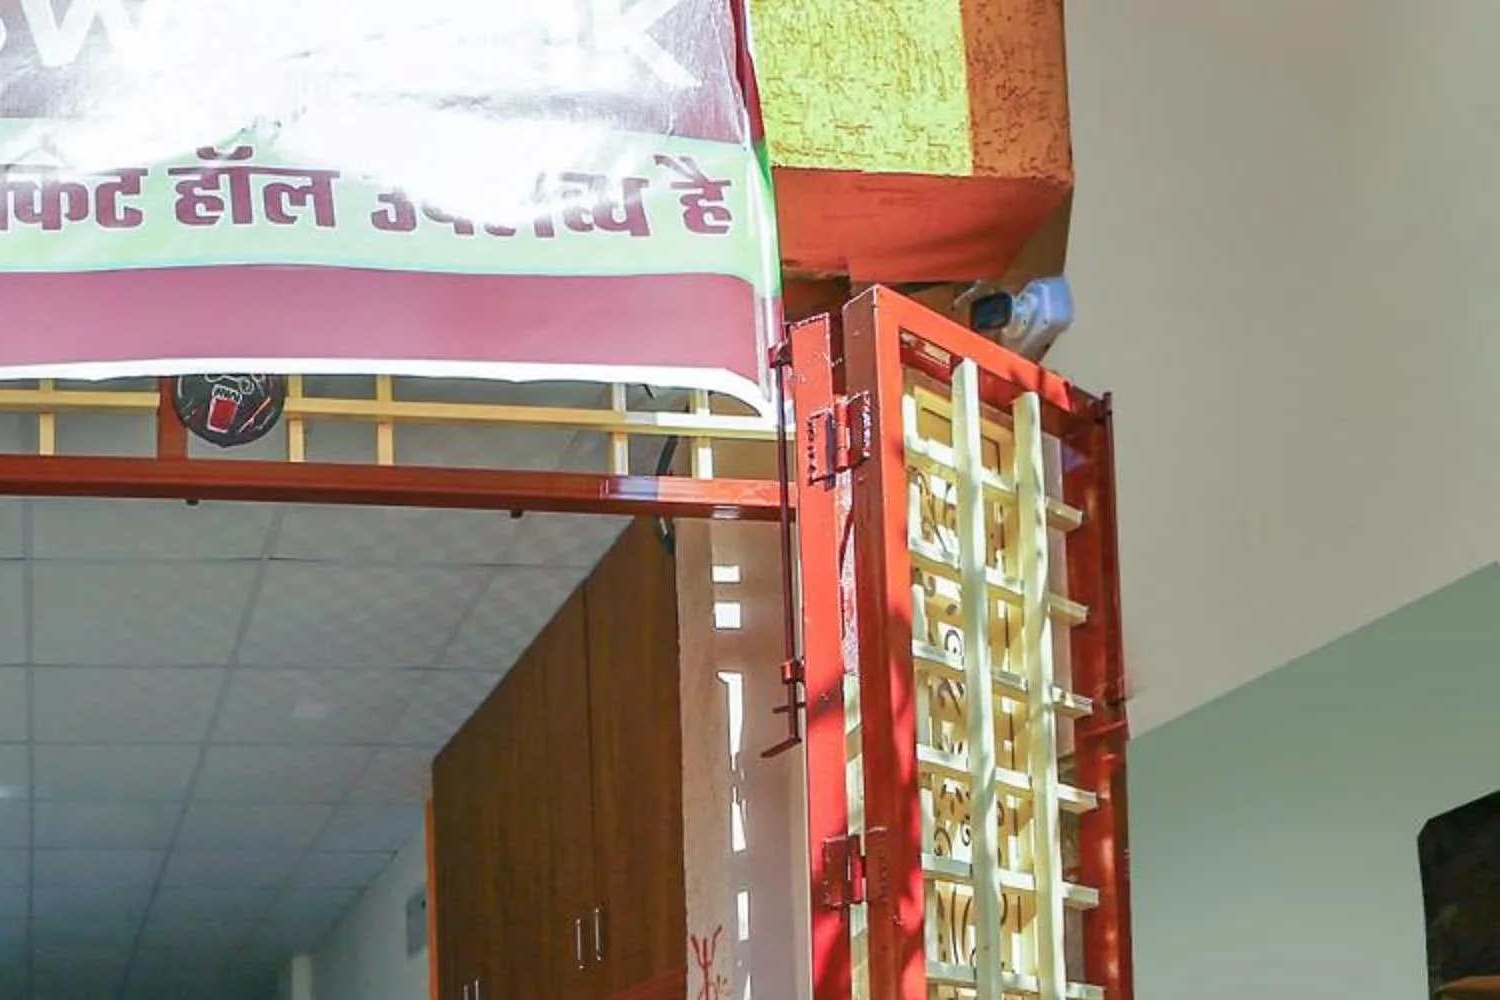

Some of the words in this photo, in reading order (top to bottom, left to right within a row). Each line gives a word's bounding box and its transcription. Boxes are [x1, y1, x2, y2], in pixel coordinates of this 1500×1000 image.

[168, 146, 341, 228] हॉल
[370, 170, 651, 238] उब्ध
[652, 153, 733, 236] है
